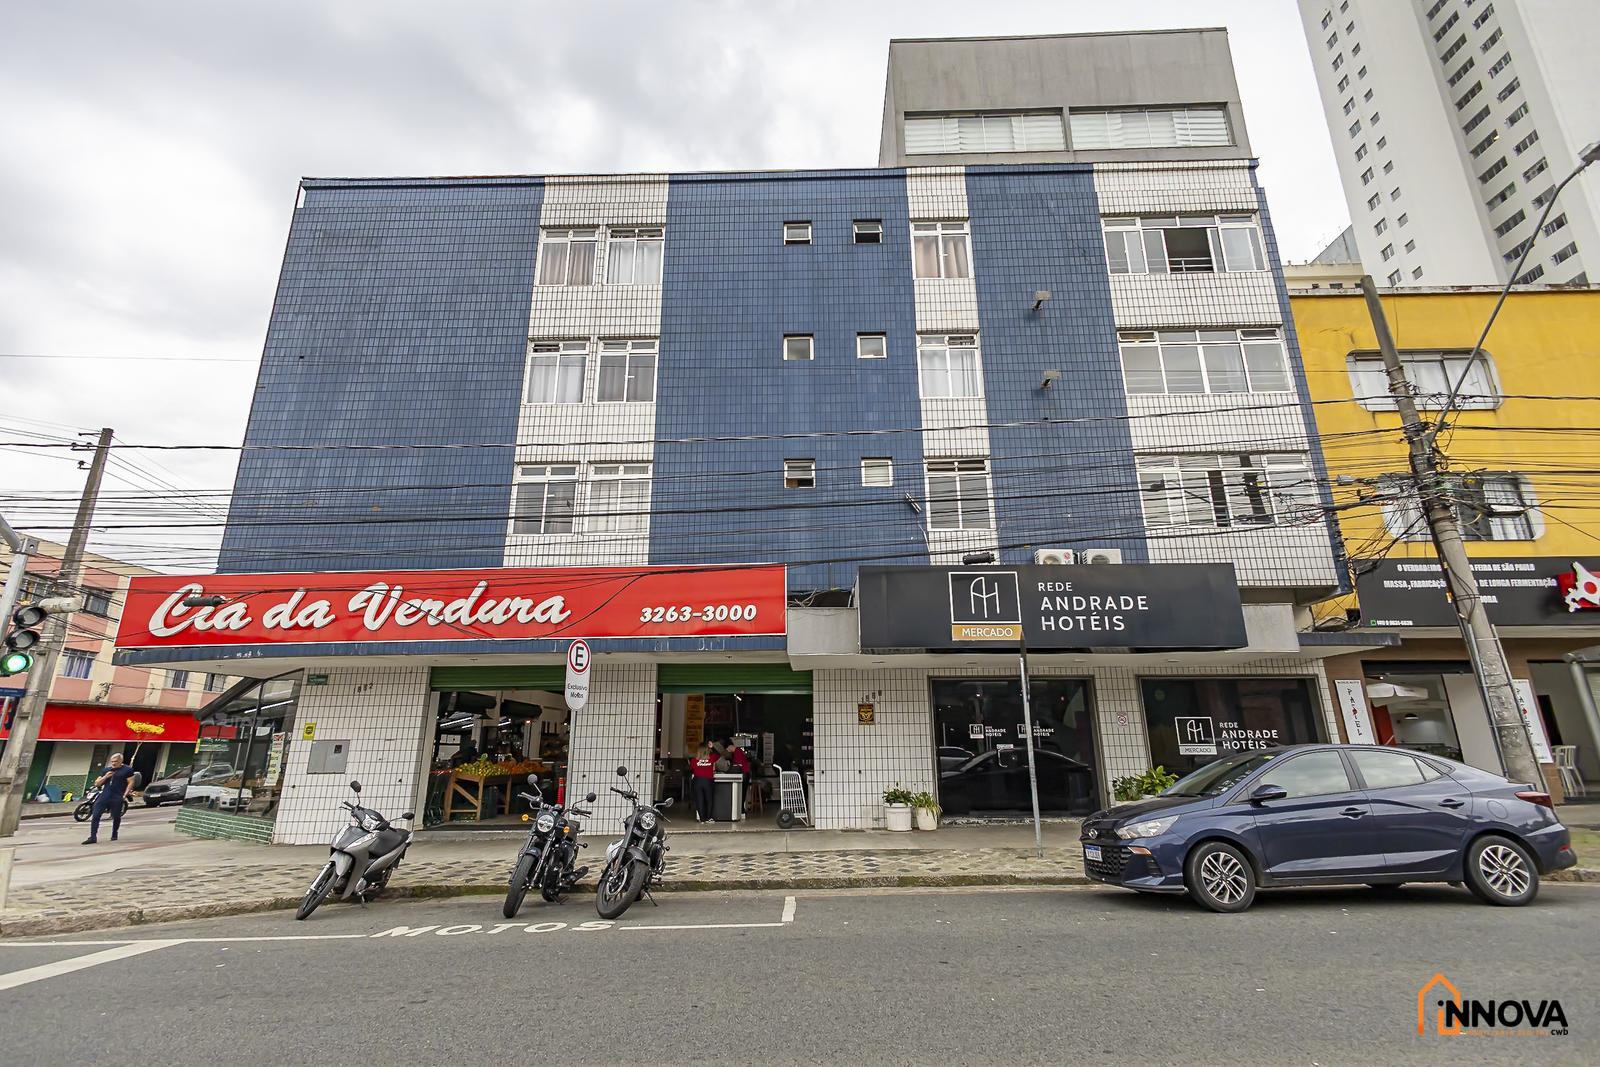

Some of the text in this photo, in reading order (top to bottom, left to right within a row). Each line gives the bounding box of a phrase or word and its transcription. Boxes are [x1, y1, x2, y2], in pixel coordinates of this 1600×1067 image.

[1038, 582, 1073, 592] REDE
[148, 581, 571, 637] Cia da Verdura
[1040, 595, 1149, 611] ANDRADE
[639, 604, 758, 623] 3263-3000
[1041, 611, 1126, 631] HOTÉIS
[961, 627, 1013, 638] MERCADO
[575, 646, 585, 666] E
[570, 691, 584, 699] Motos
[1221, 730, 1279, 739] ANDRADE
[1222, 739, 1267, 750] HOTÉIS
[369, 920, 616, 938] MOTOS
